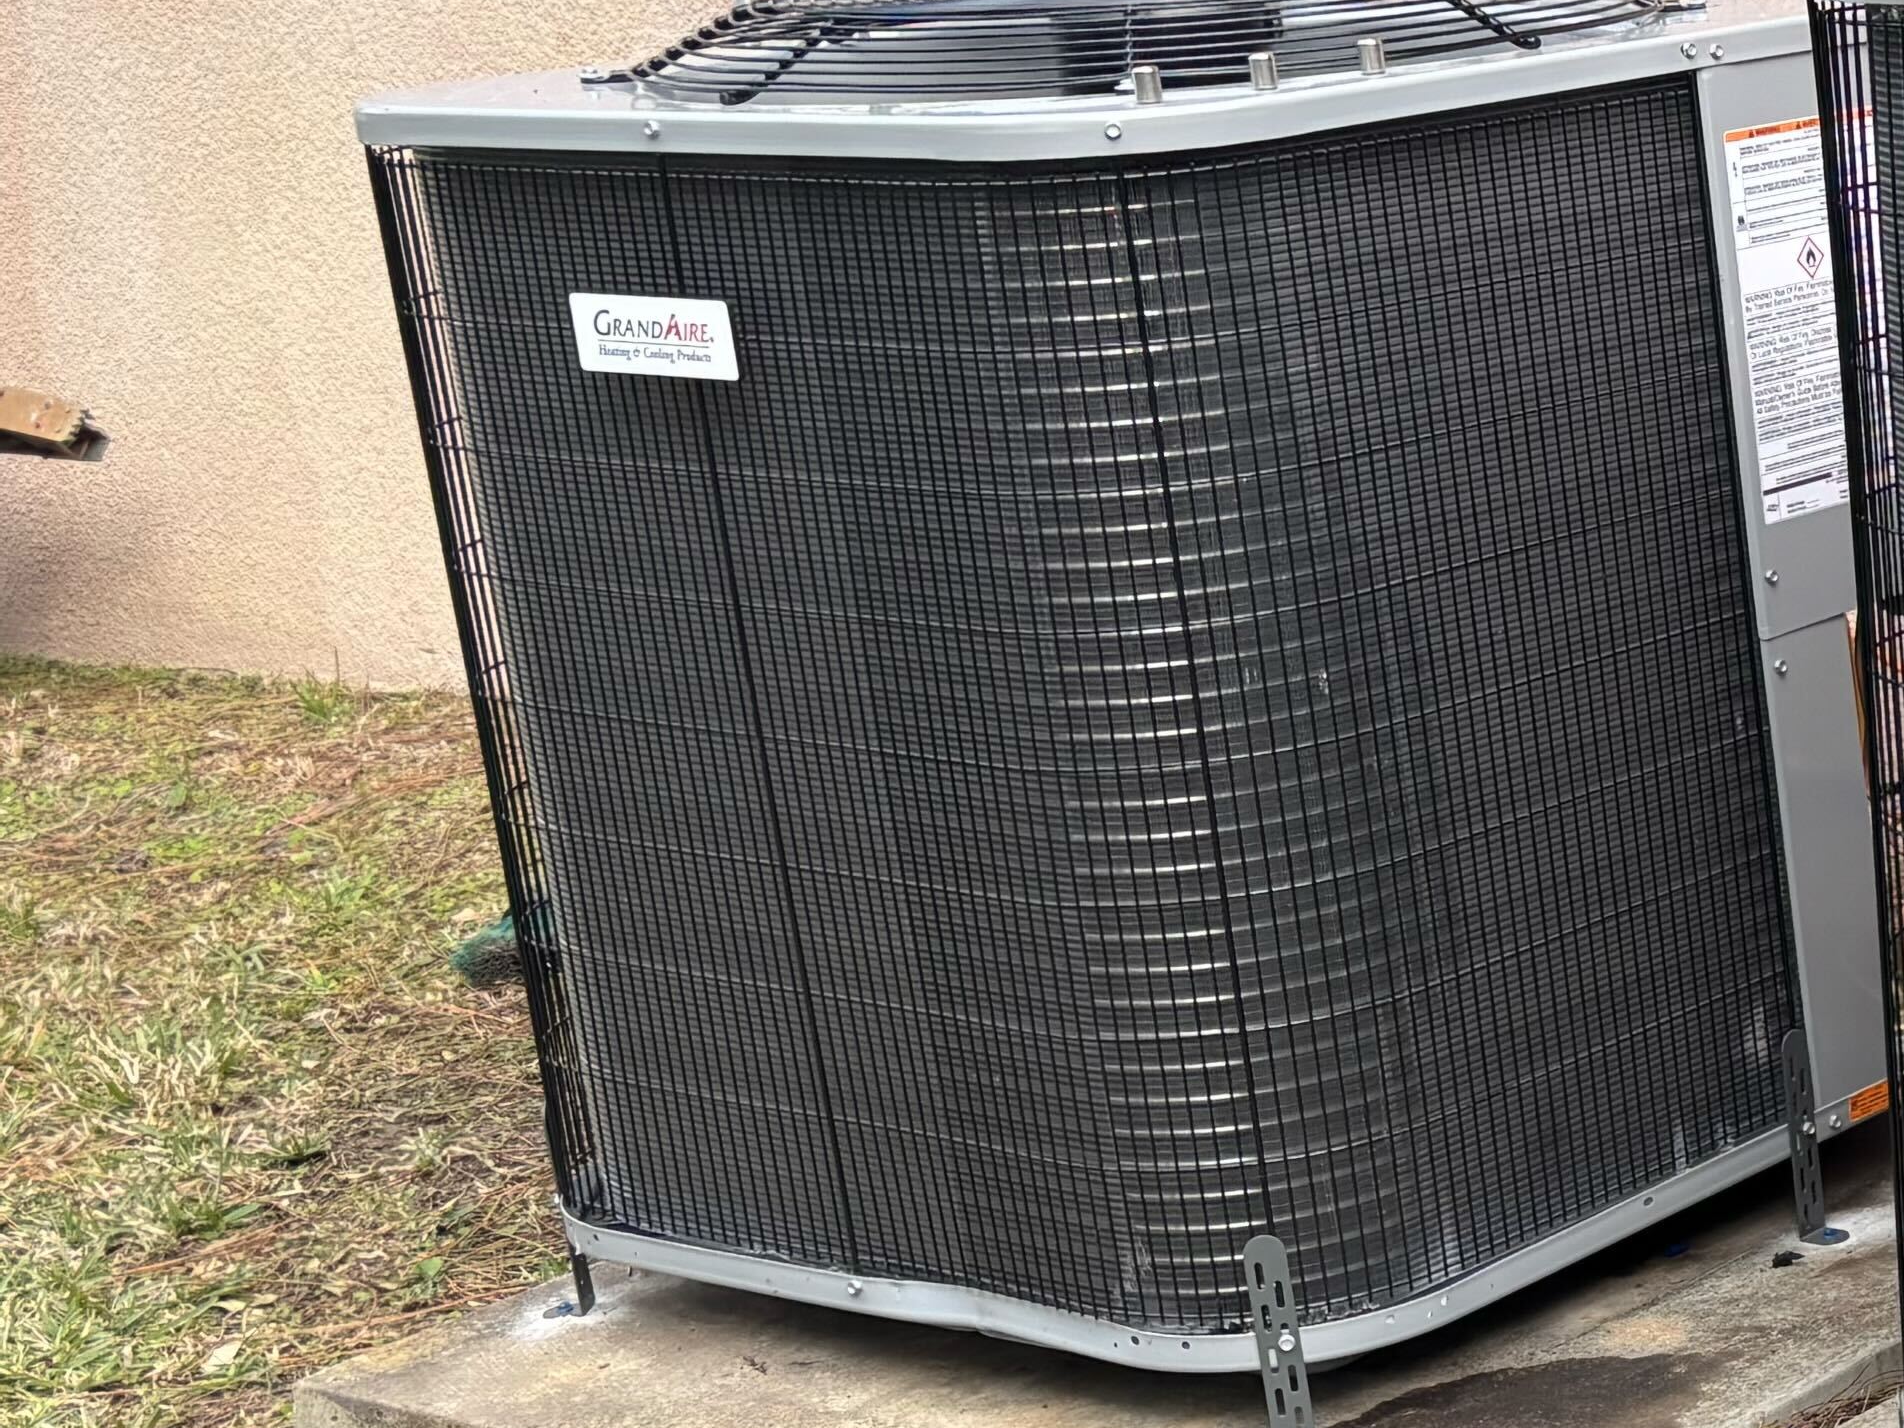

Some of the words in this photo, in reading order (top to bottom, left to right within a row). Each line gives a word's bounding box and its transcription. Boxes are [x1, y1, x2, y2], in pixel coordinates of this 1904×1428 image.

[599, 344, 632, 361] Heating
[644, 347, 675, 364] Cooling
[677, 349, 711, 363] Products
